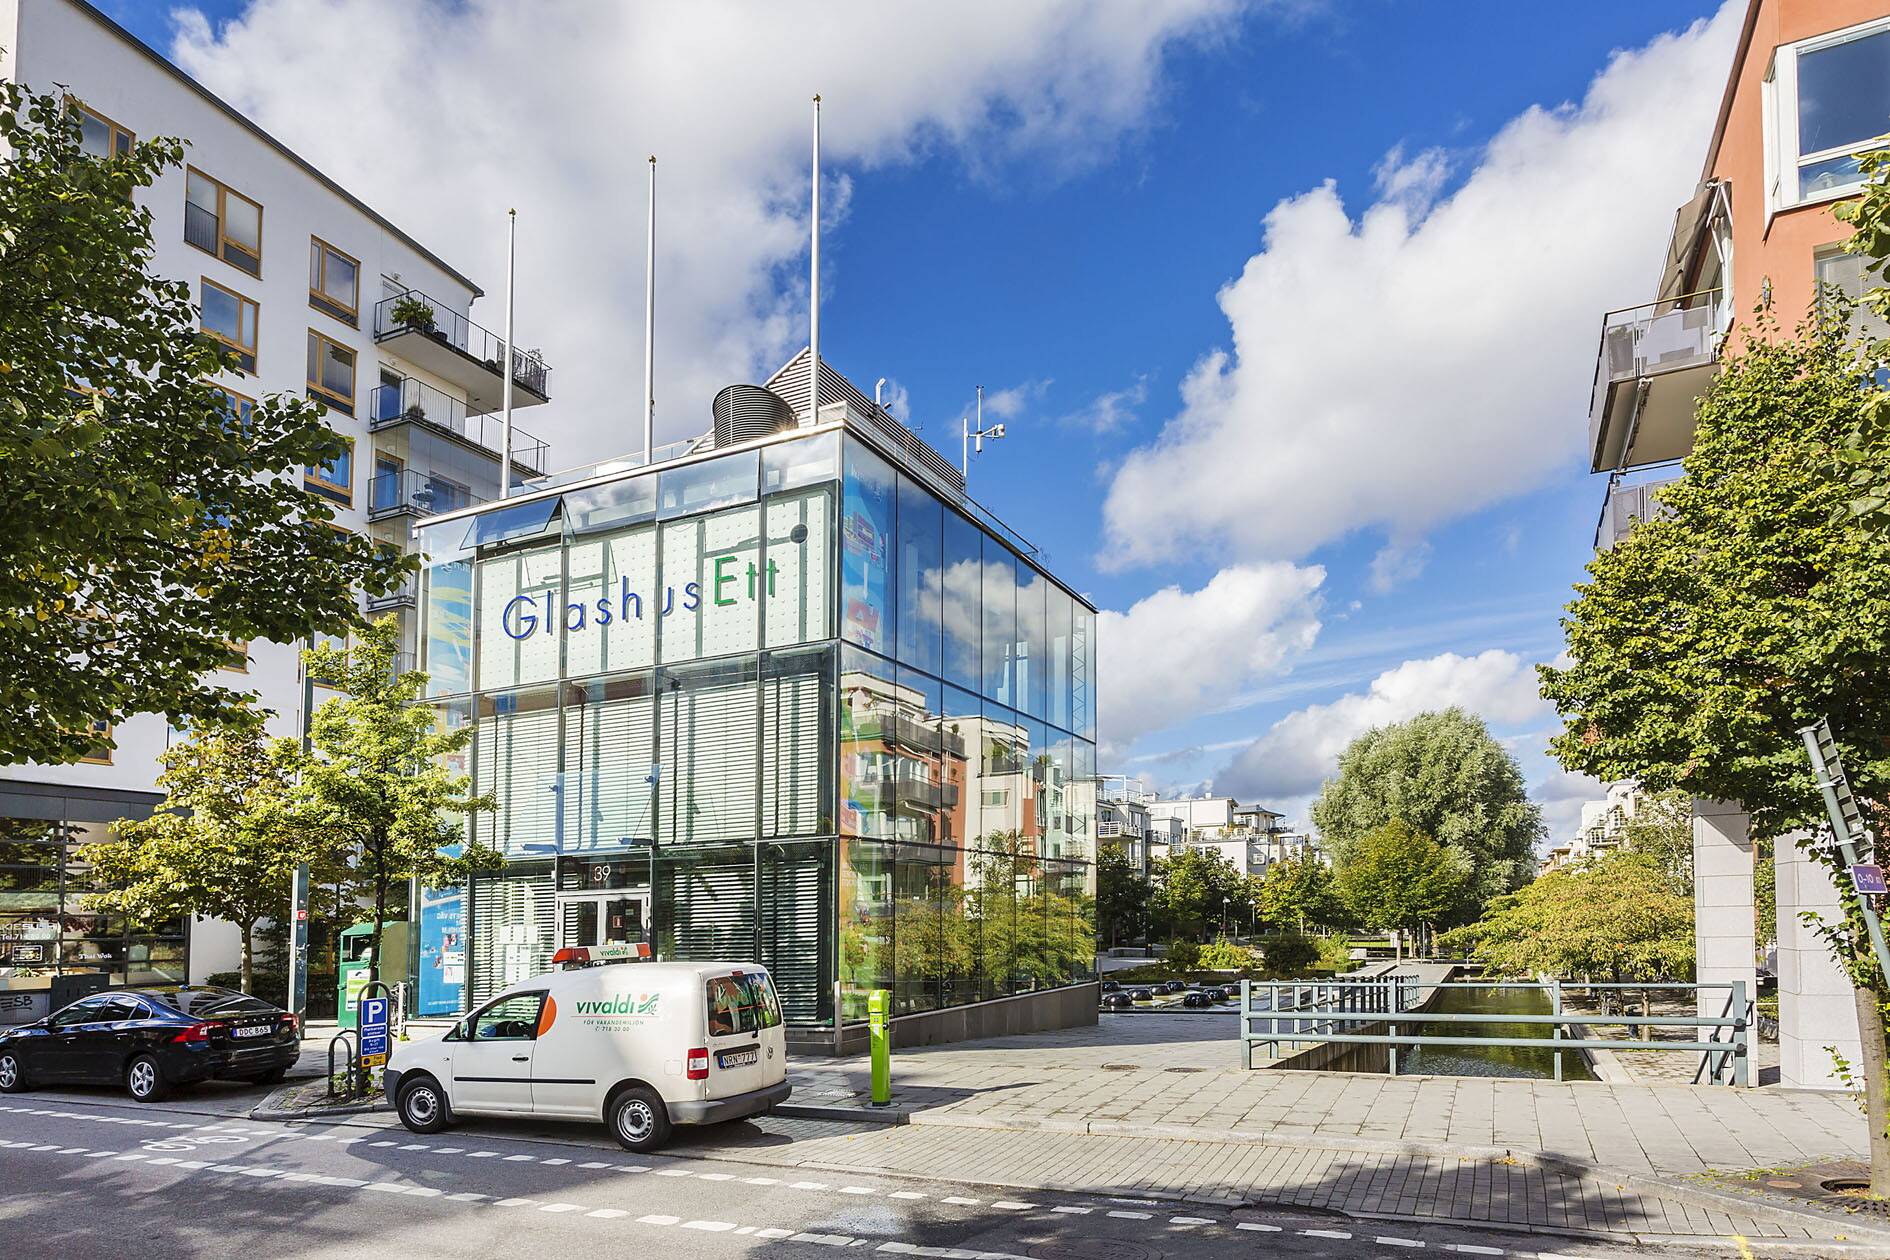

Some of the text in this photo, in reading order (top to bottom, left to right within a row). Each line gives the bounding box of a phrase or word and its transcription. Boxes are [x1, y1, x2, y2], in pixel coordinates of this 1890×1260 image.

[593, 865, 611, 881] 39
[576, 993, 635, 1014] vivaldi
[368, 1001, 384, 1023] P
[254, 1026, 269, 1035] 865
[723, 1051, 754, 1065] NRN 777
